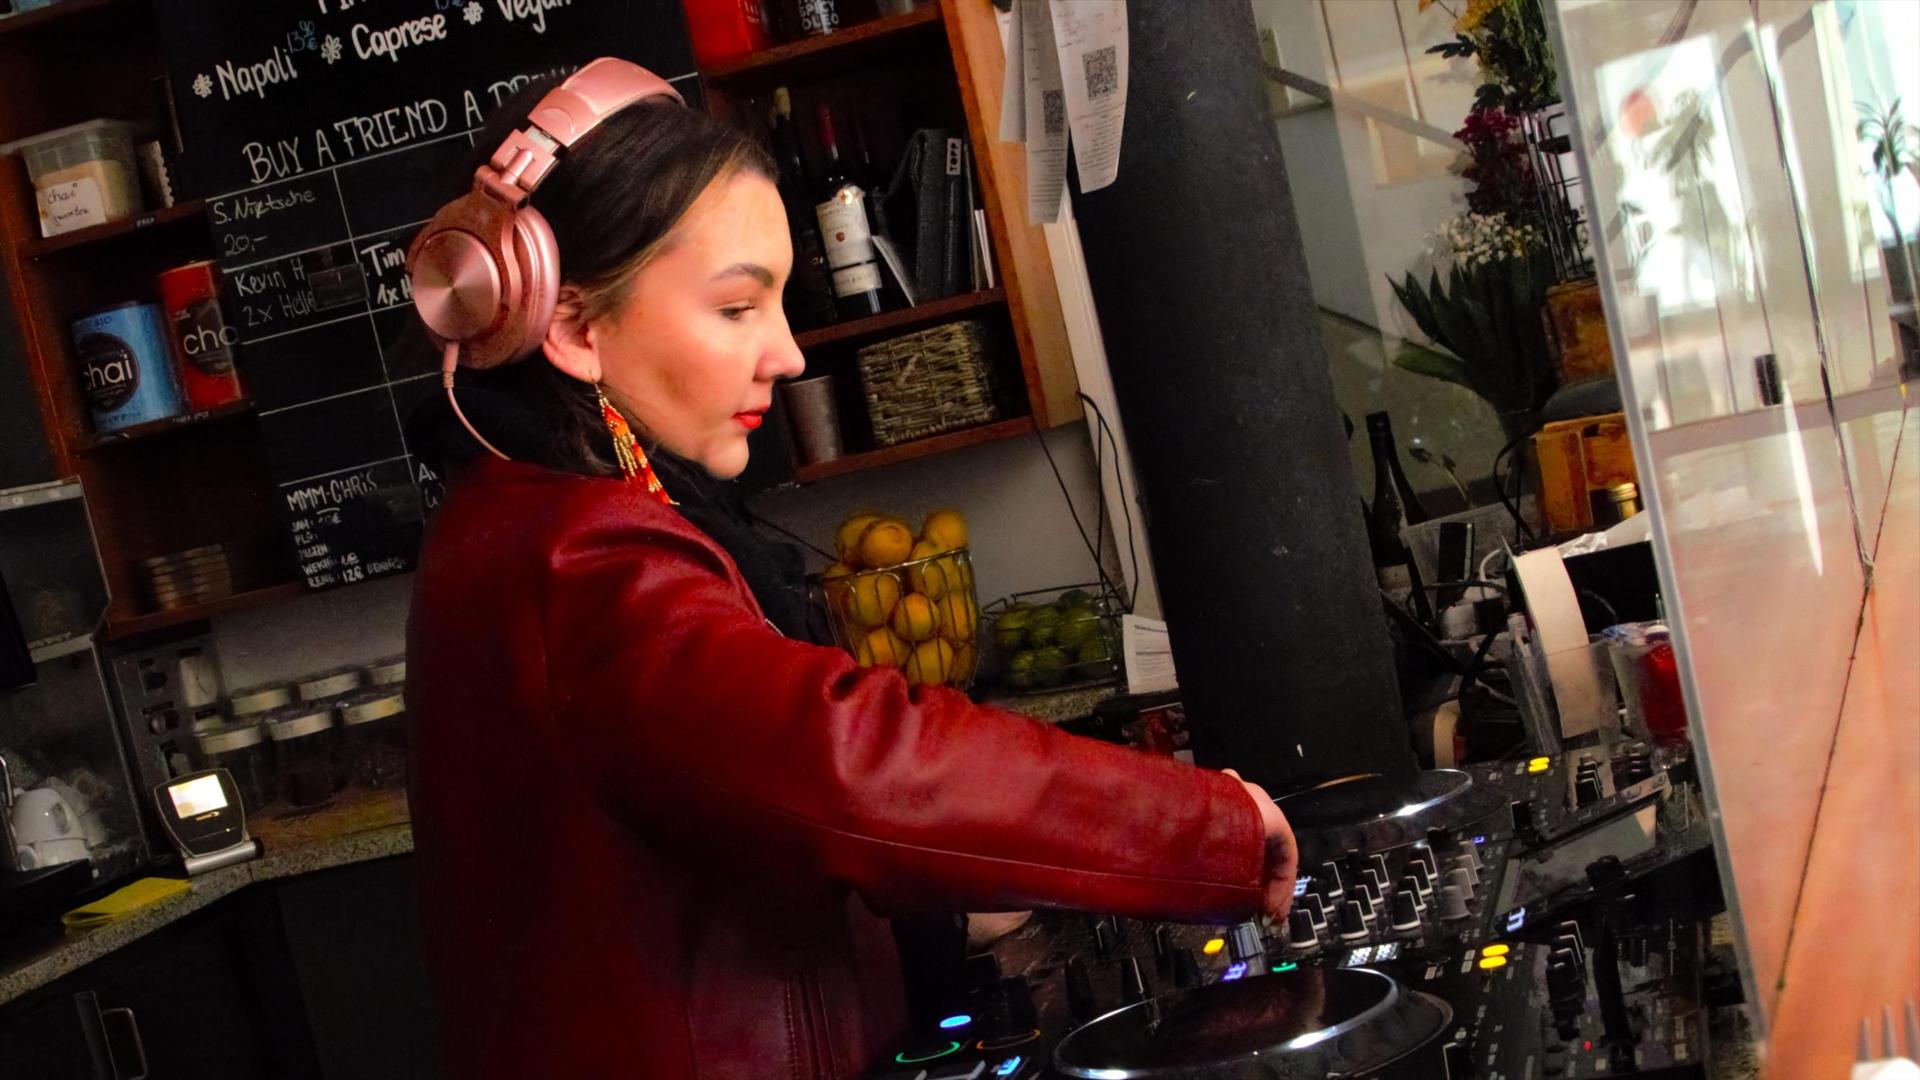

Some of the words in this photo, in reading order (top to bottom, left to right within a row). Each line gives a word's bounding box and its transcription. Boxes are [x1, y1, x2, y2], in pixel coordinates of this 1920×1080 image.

[351, 13, 448, 62] Caprese
[215, 46, 298, 100] Napoli
[243, 136, 304, 184] BUY
[315, 129, 337, 168] A
[335, 100, 448, 158] FRIEND
[464, 89, 484, 126] A
[234, 272, 287, 297] Kevin
